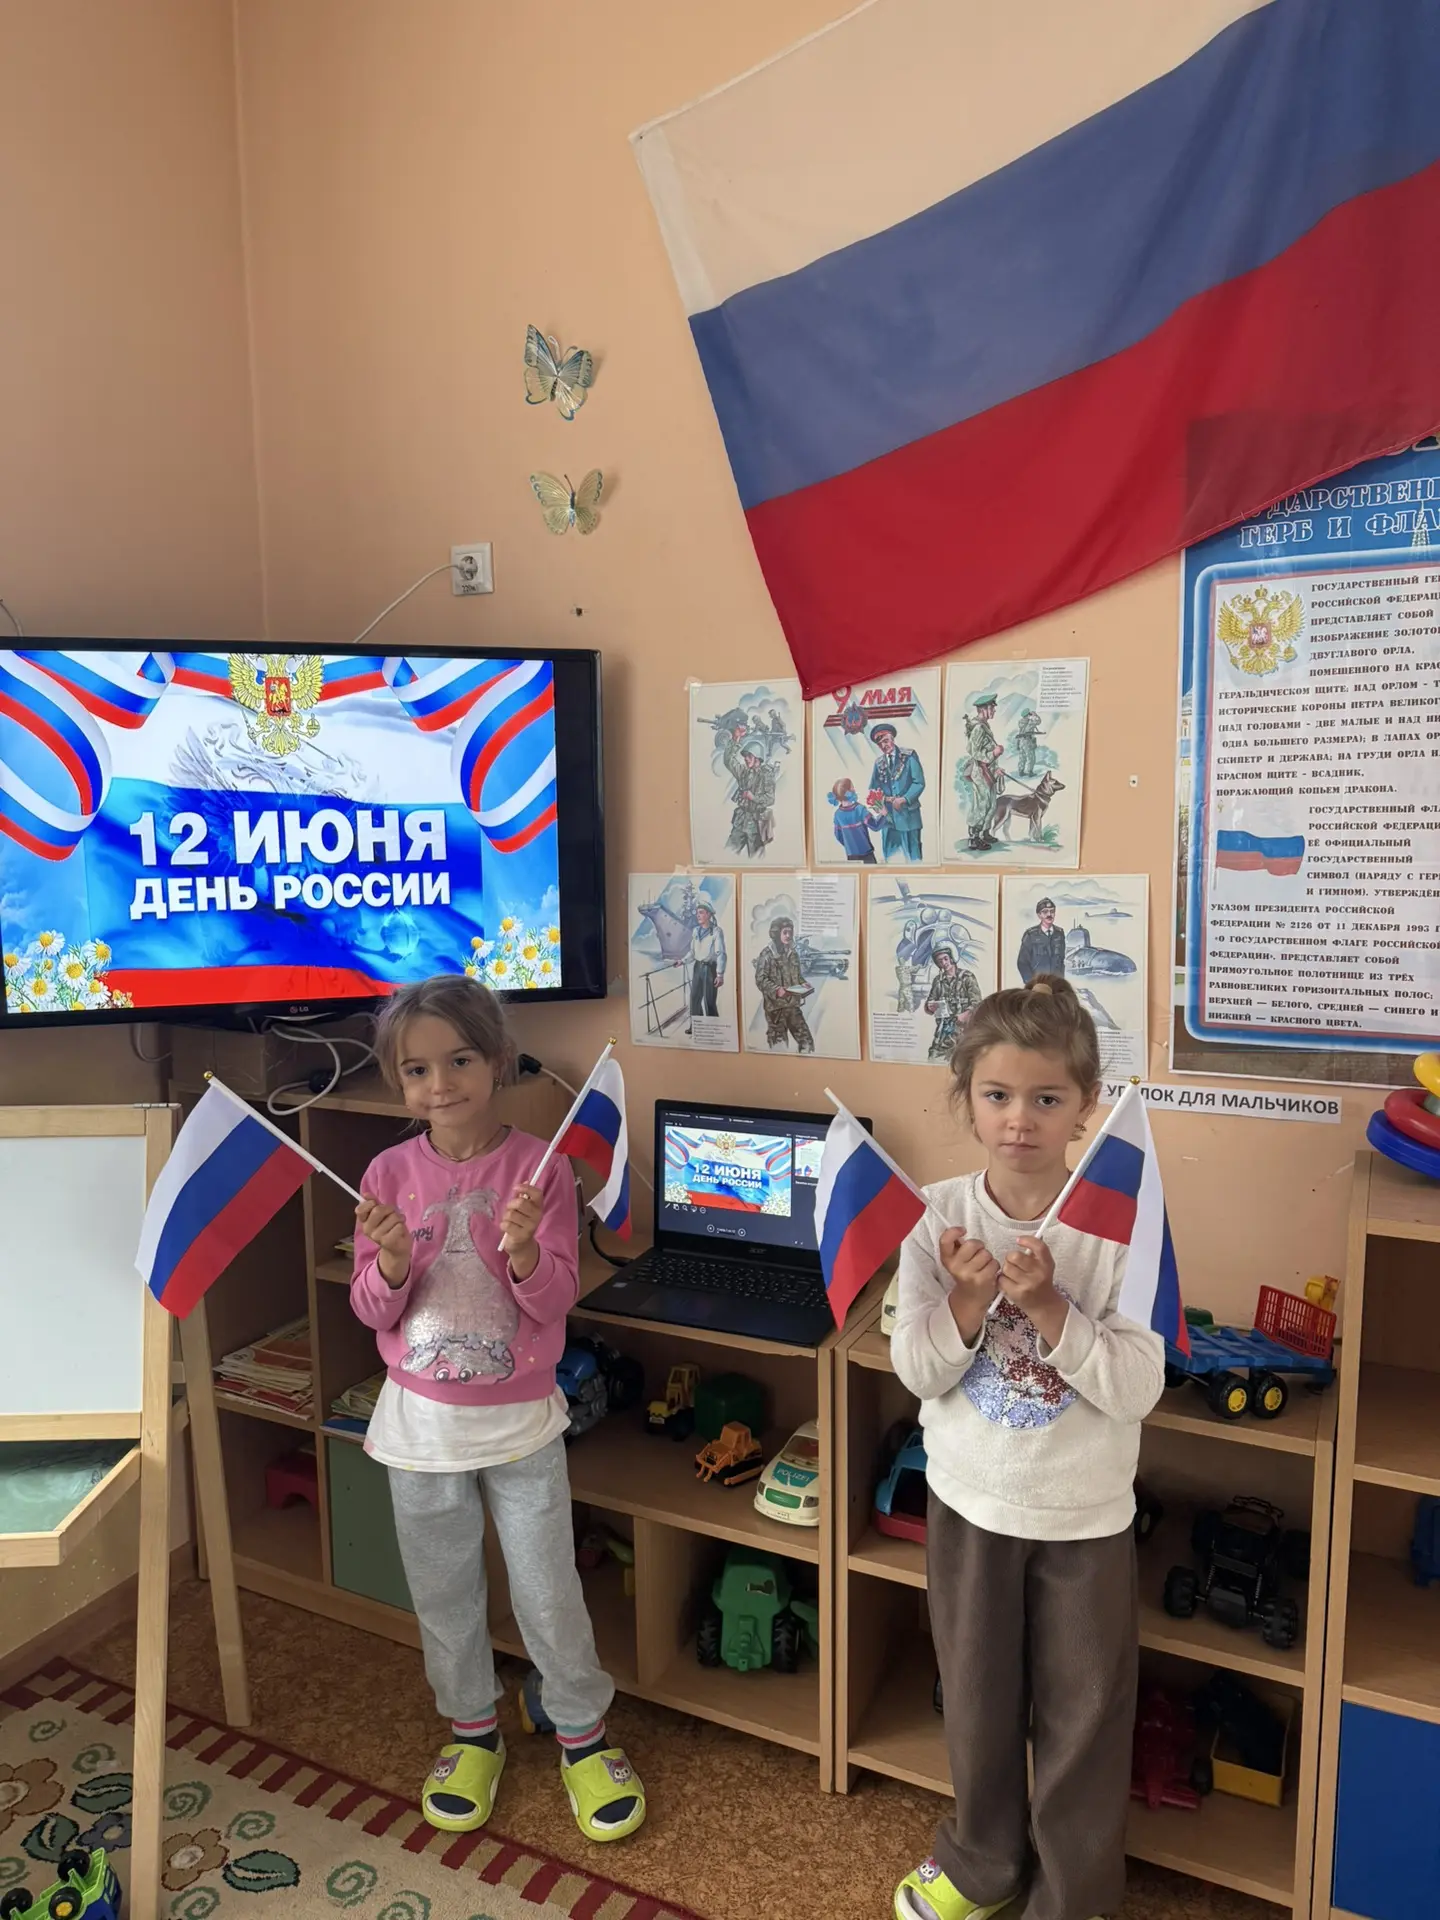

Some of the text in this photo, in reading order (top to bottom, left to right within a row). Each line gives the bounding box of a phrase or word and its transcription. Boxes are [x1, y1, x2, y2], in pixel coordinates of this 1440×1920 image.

[1240, 508, 1440, 548] ГЕРБ И ФЛА
[1311, 575, 1440, 592] ГОСУДАРСТВЕННЫЙ ГЕ
[1312, 592, 1440, 608] РОССИЙСКОЙ ФЕДЕРАЦ
[1311, 609, 1433, 625] ПРЕДСТАВЛЯЕТ СОБОЙ
[1311, 627, 1440, 642] ИЗОБРАЖЕНИЕ ЗОЛОТО
[1310, 648, 1377, 660] ДВУГЛАВОГО
[860, 686, 912, 706] МАЯ
[1219, 688, 1309, 699] ГЕРАЛЬДИЧЕСКОМ
[1382, 682, 1417, 690] ОРЛОМ
[1219, 705, 1296, 715] ИСТОРИЧЕСКИЕ
[1302, 702, 1345, 711] КОРОНЫ
[1351, 700, 1384, 708] ПЕТРА
[1219, 724, 1242, 732] (НАД
[1247, 722, 1300, 730] ГОЛОВАМИ
[1316, 720, 1335, 728] ДВЕ
[1341, 718, 1379, 726] МАЛЫЕ
[1399, 716, 1420, 724] НАД
[1222, 740, 1248, 748] ОДНА
[1254, 738, 1308, 746] БОЛЬШЕГО
[1384, 733, 1420, 741] ЛАПАХ
[1217, 756, 1262, 764] СКИПЕТР
[1357, 751, 1391, 759] ГРУДИ
[1398, 750, 1425, 758] ОРЛА
[1217, 772, 1262, 780] КРАСНОМ
[1267, 771, 1297, 779] ЩИТЕ
[1217, 787, 1293, 796] ПОРАЖАЮЩИЙ
[1310, 804, 1415, 814] ГОСУДАРСТВЕННЫЙ
[1309, 822, 1377, 830] РОССИЙСКОЙ
[129, 808, 447, 866] 12 ИЮНЯ
[1325, 838, 1410, 847] ОФИЦИАЛЬНЫЙ
[1308, 855, 1412, 863] ГОСУДАРСТВЕННЫЙ
[1355, 872, 1401, 880] (НАРЯДУ
[129, 872, 451, 920] ДЕНЬ РОССИИ
[1255, 905, 1319, 913] ПРЕЗИДЕНТА
[1326, 906, 1394, 914] РОССИЙСКОЙ
[1211, 920, 1270, 928] ФЕДЕРАЦИИ
[1352, 923, 1400, 931] ДЕКАБРЯ
[1230, 936, 1326, 945] ГОСУДАРСТВЕННОМ
[1281, 954, 1359, 963] ПРЕДСТАВЛЯЕТ
[1365, 956, 1399, 964] СОБОЙ
[1210, 966, 1293, 976] ПРЯМОУГОЛЬНОЕ
[1298, 970, 1364, 979] ПОЛОТНИЩЕ
[1209, 982, 1287, 992] РАВНОВЕЛИКИХ
[1293, 986, 1388, 997] ГОРИЗОНТАЛЬНЫХ
[1209, 997, 1252, 1006] ВЕРХНЕЙ
[1318, 1003, 1363, 1011] СРЕДНЕЙ
[1384, 1007, 1425, 1015] СИНЕГО
[1209, 1012, 1251, 1021] НИЖНЕЙ
[1271, 1016, 1321, 1025] КРАСНОГО
[1107, 1084, 1339, 1115] УГЛОК ДЛЯ МАЛЬЧИКОВ
[694, 1163, 762, 1180] 12 ИЮНЯ
[692, 1174, 763, 1189] ДЕНЬ РОССИИ
[777, 1468, 811, 1482] POLIZEI
